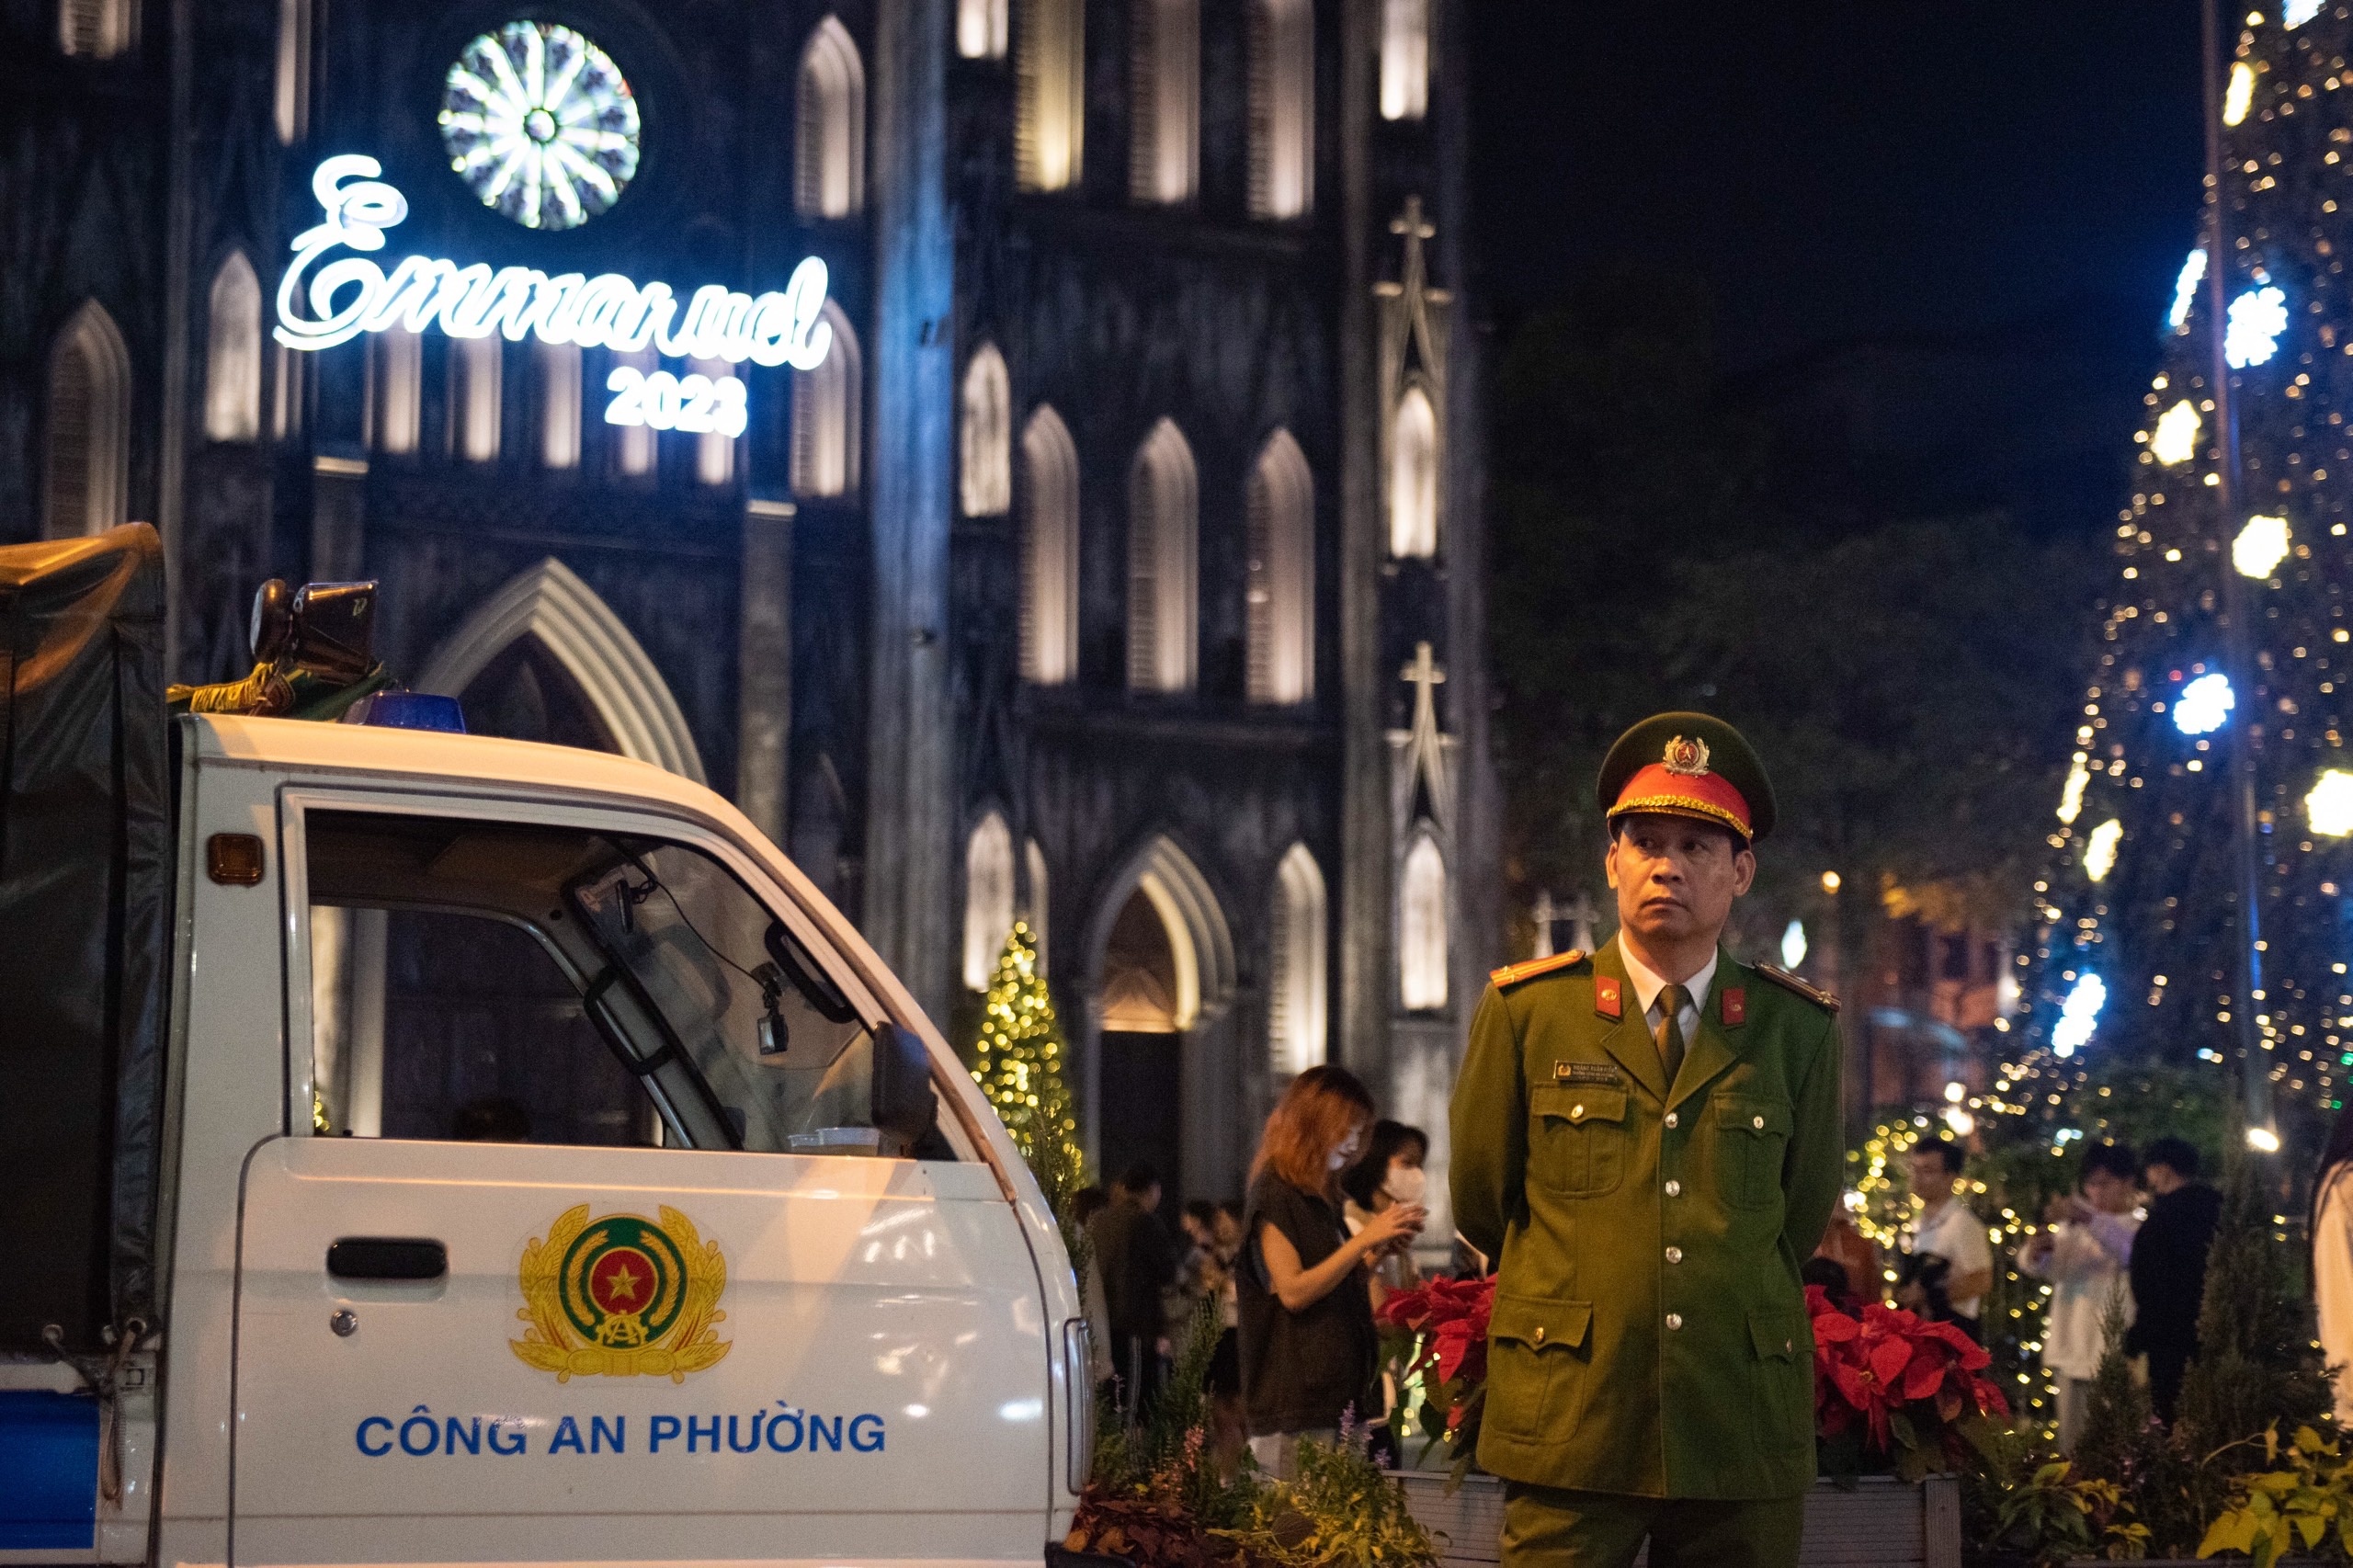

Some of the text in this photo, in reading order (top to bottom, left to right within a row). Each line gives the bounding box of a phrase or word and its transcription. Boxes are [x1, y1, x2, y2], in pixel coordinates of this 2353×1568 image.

[273, 154, 832, 370] Emmanuel
[605, 366, 747, 438] 2023
[356, 1401, 886, 1457] CÔNG AN PHƯỜNG
